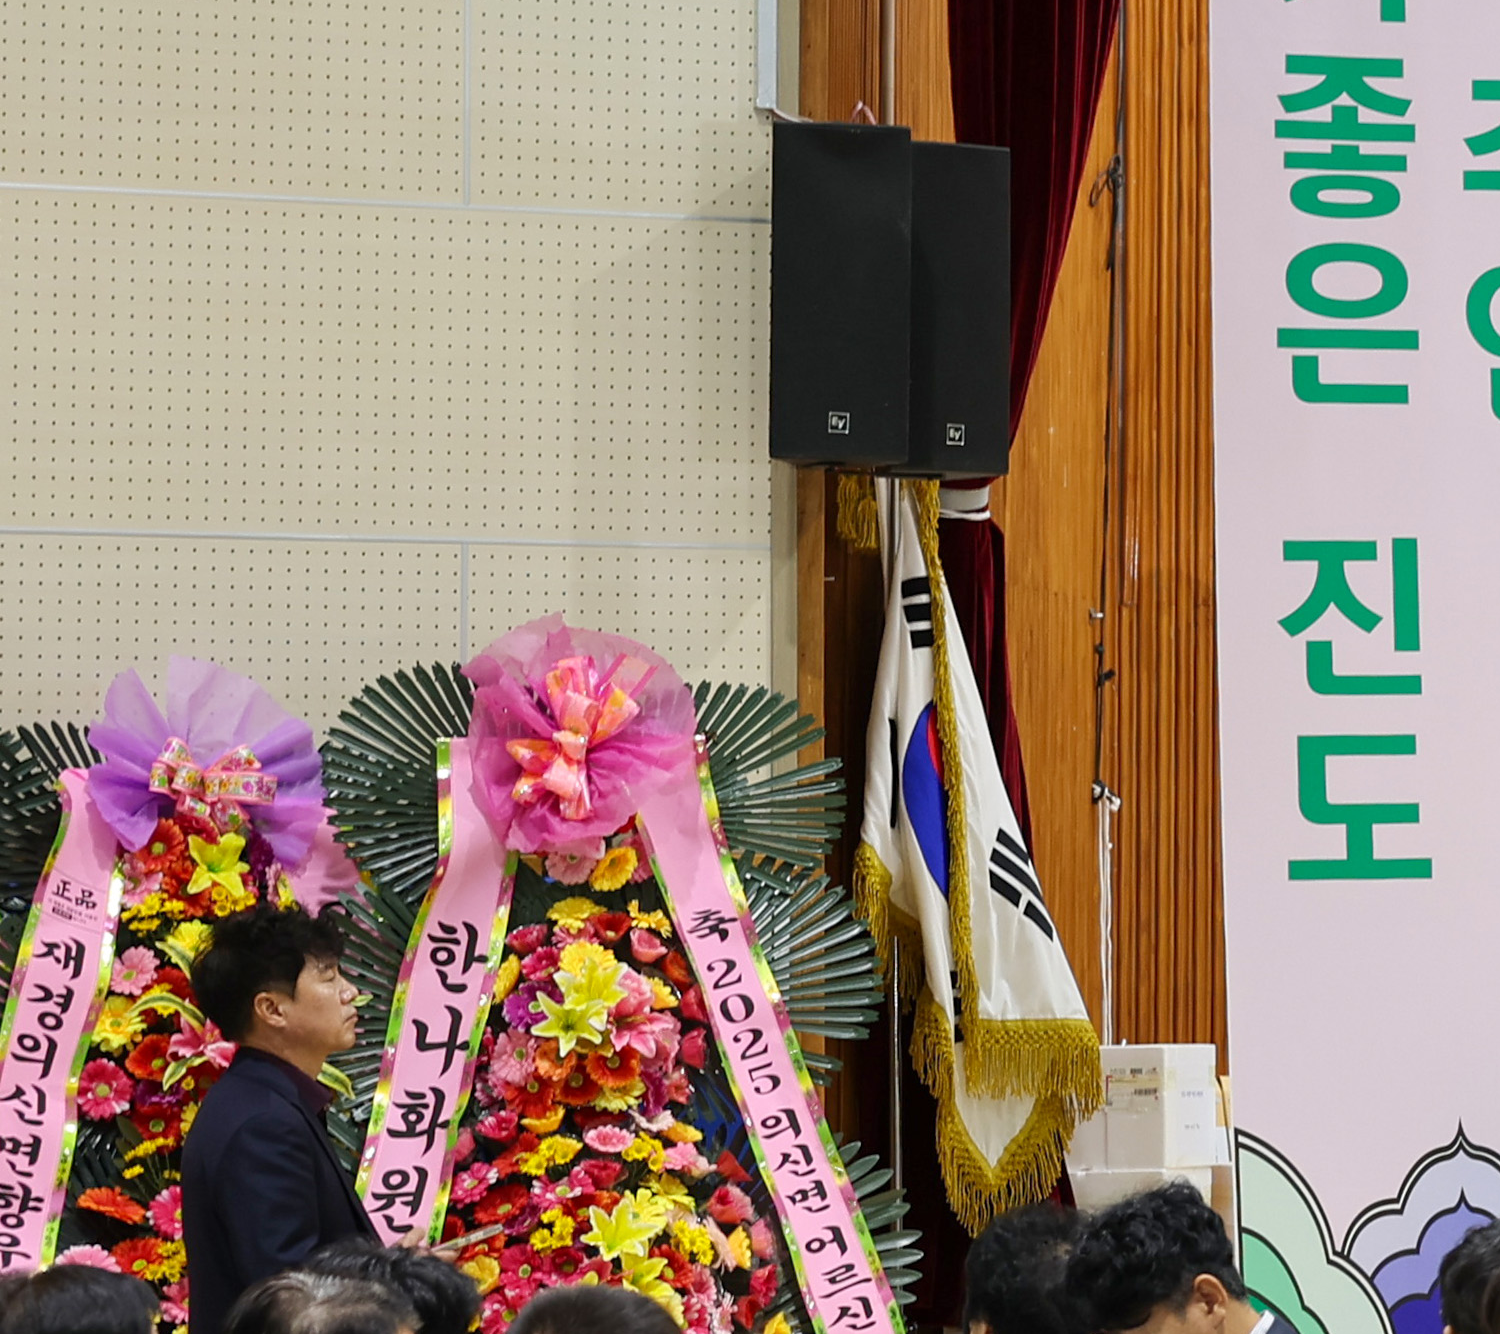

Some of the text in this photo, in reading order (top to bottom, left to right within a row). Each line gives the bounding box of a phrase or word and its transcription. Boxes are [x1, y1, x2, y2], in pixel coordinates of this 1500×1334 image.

[1276, 537, 1433, 881] 진도
[690, 908, 734, 944] 축
[706, 958, 782, 1096] 2025
[760, 1108, 831, 1213] 의신면
[804, 1224, 877, 1331] 어르신
